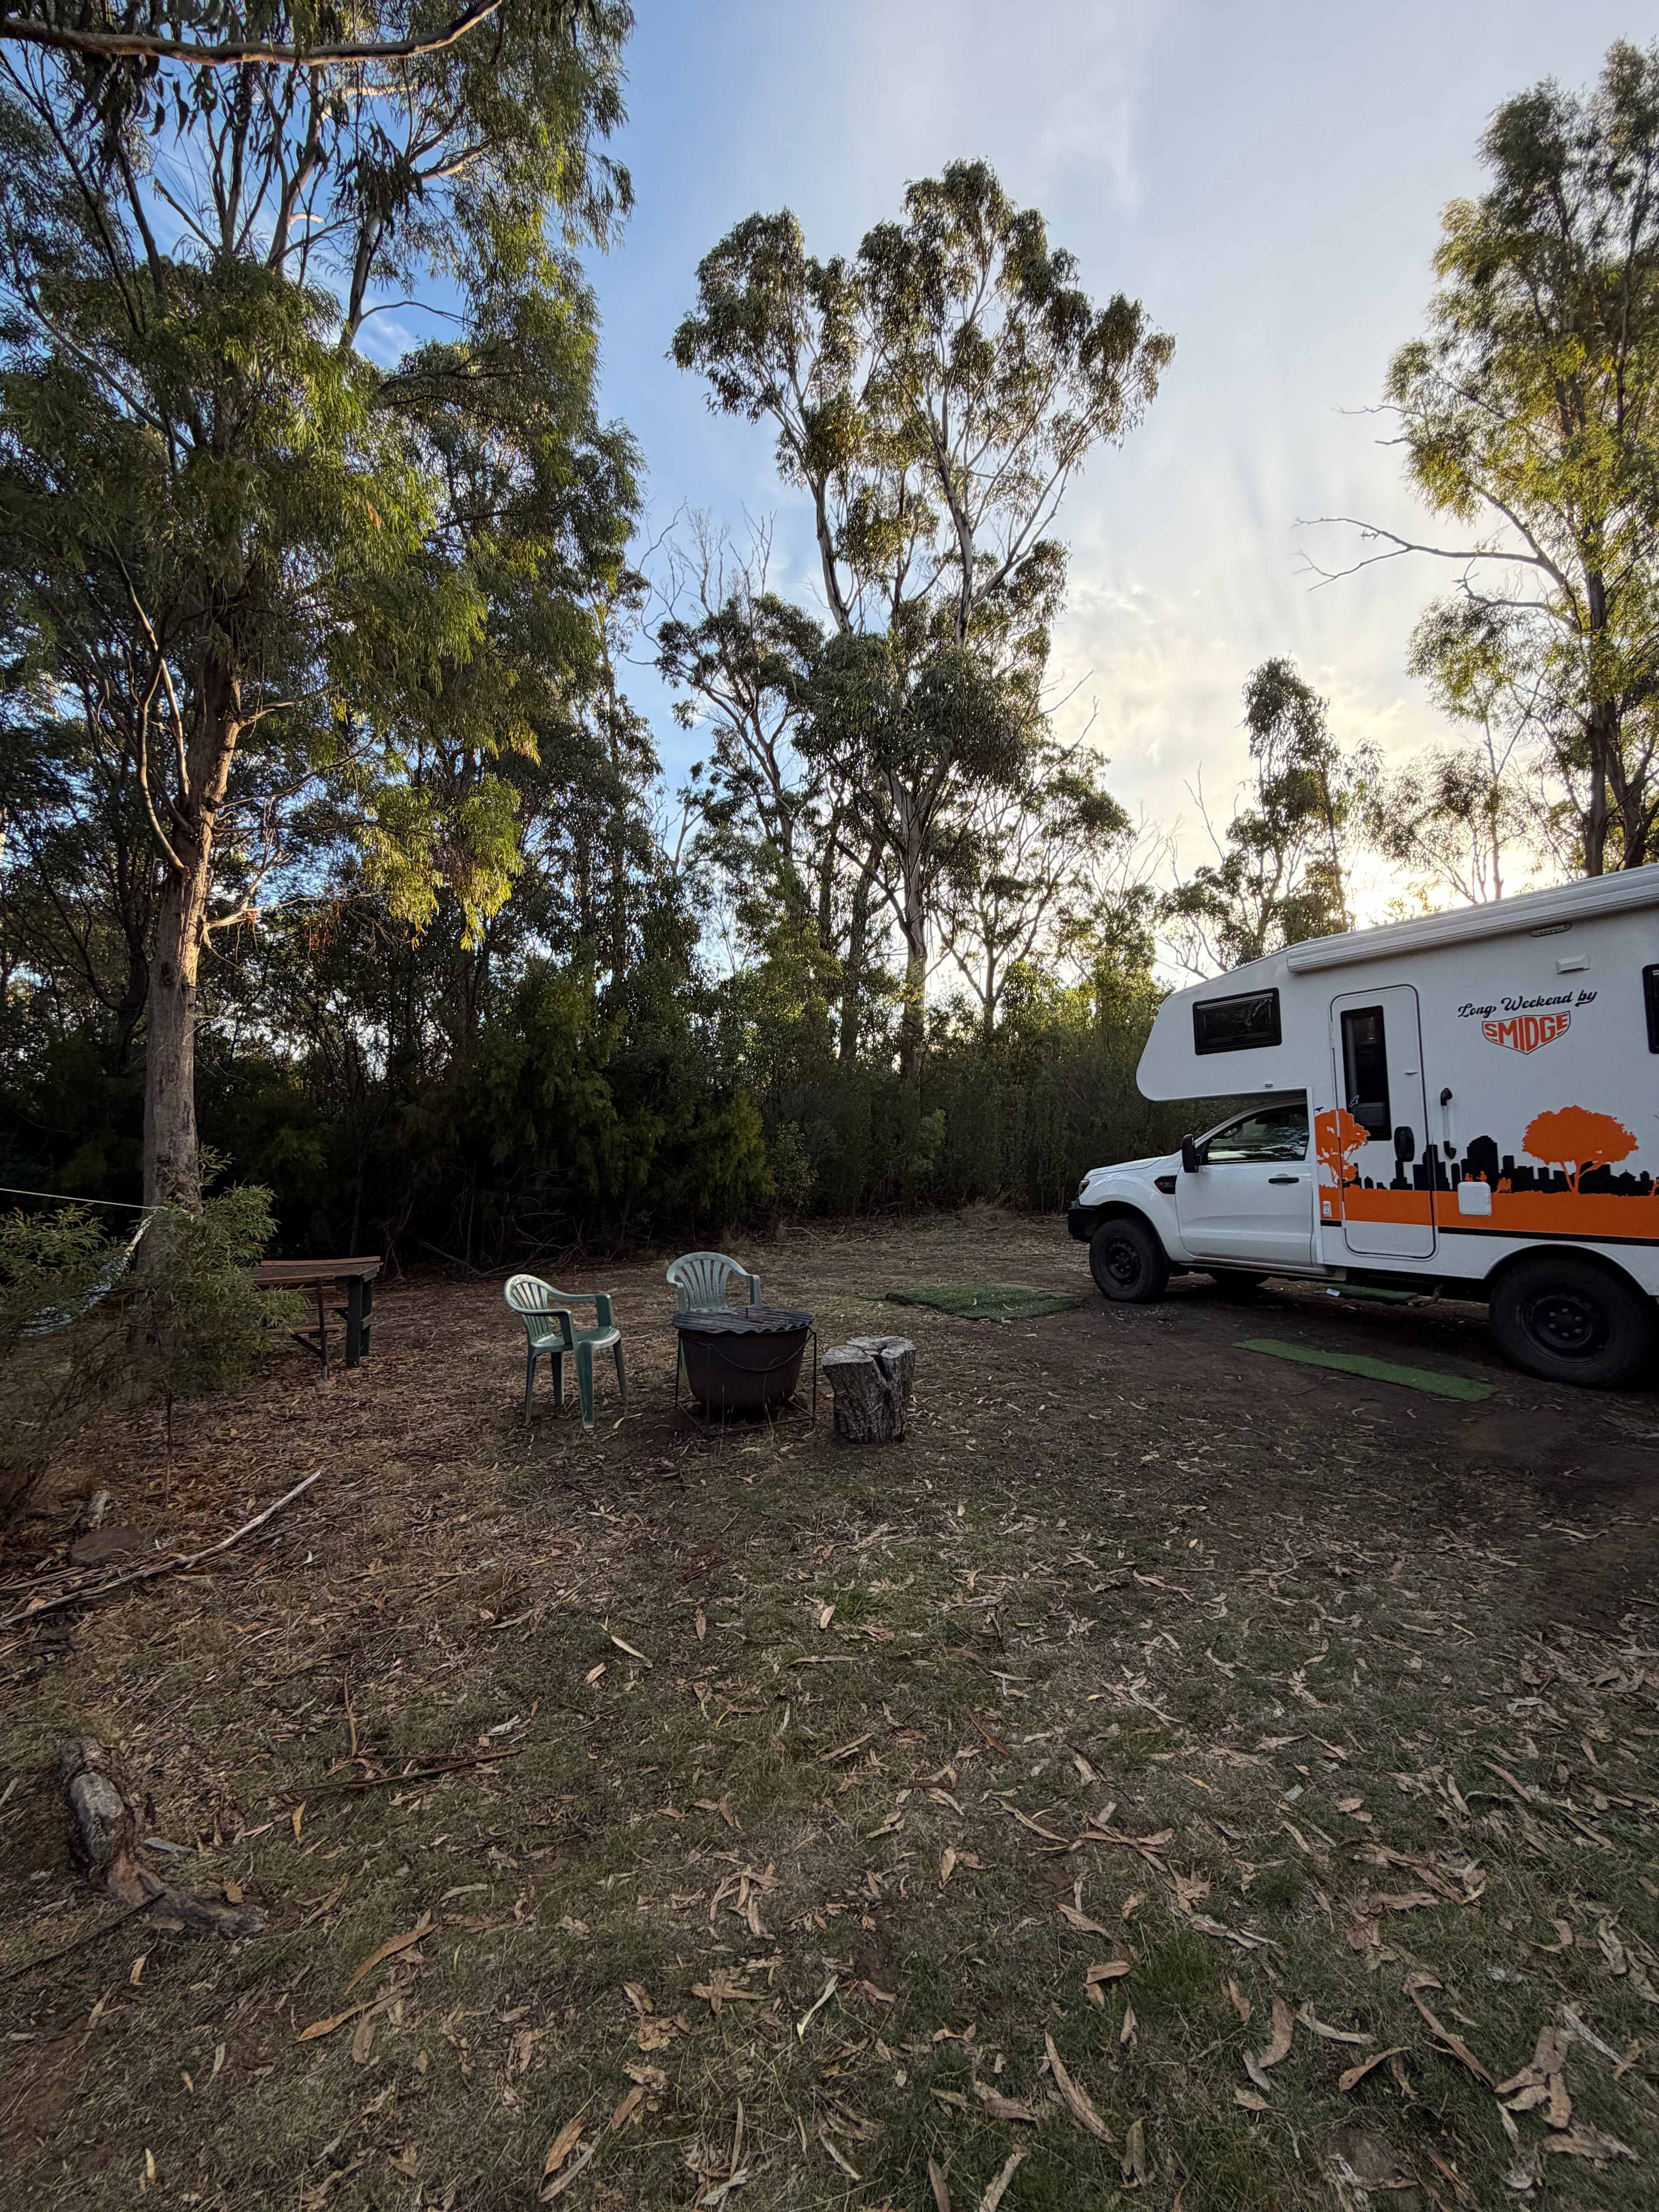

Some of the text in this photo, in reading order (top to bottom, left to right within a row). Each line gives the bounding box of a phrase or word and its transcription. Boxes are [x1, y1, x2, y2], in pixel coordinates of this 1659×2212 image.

[1458, 989, 1597, 1018] Long Weekend by
[1484, 1014, 1568, 1052] SMIDGE
